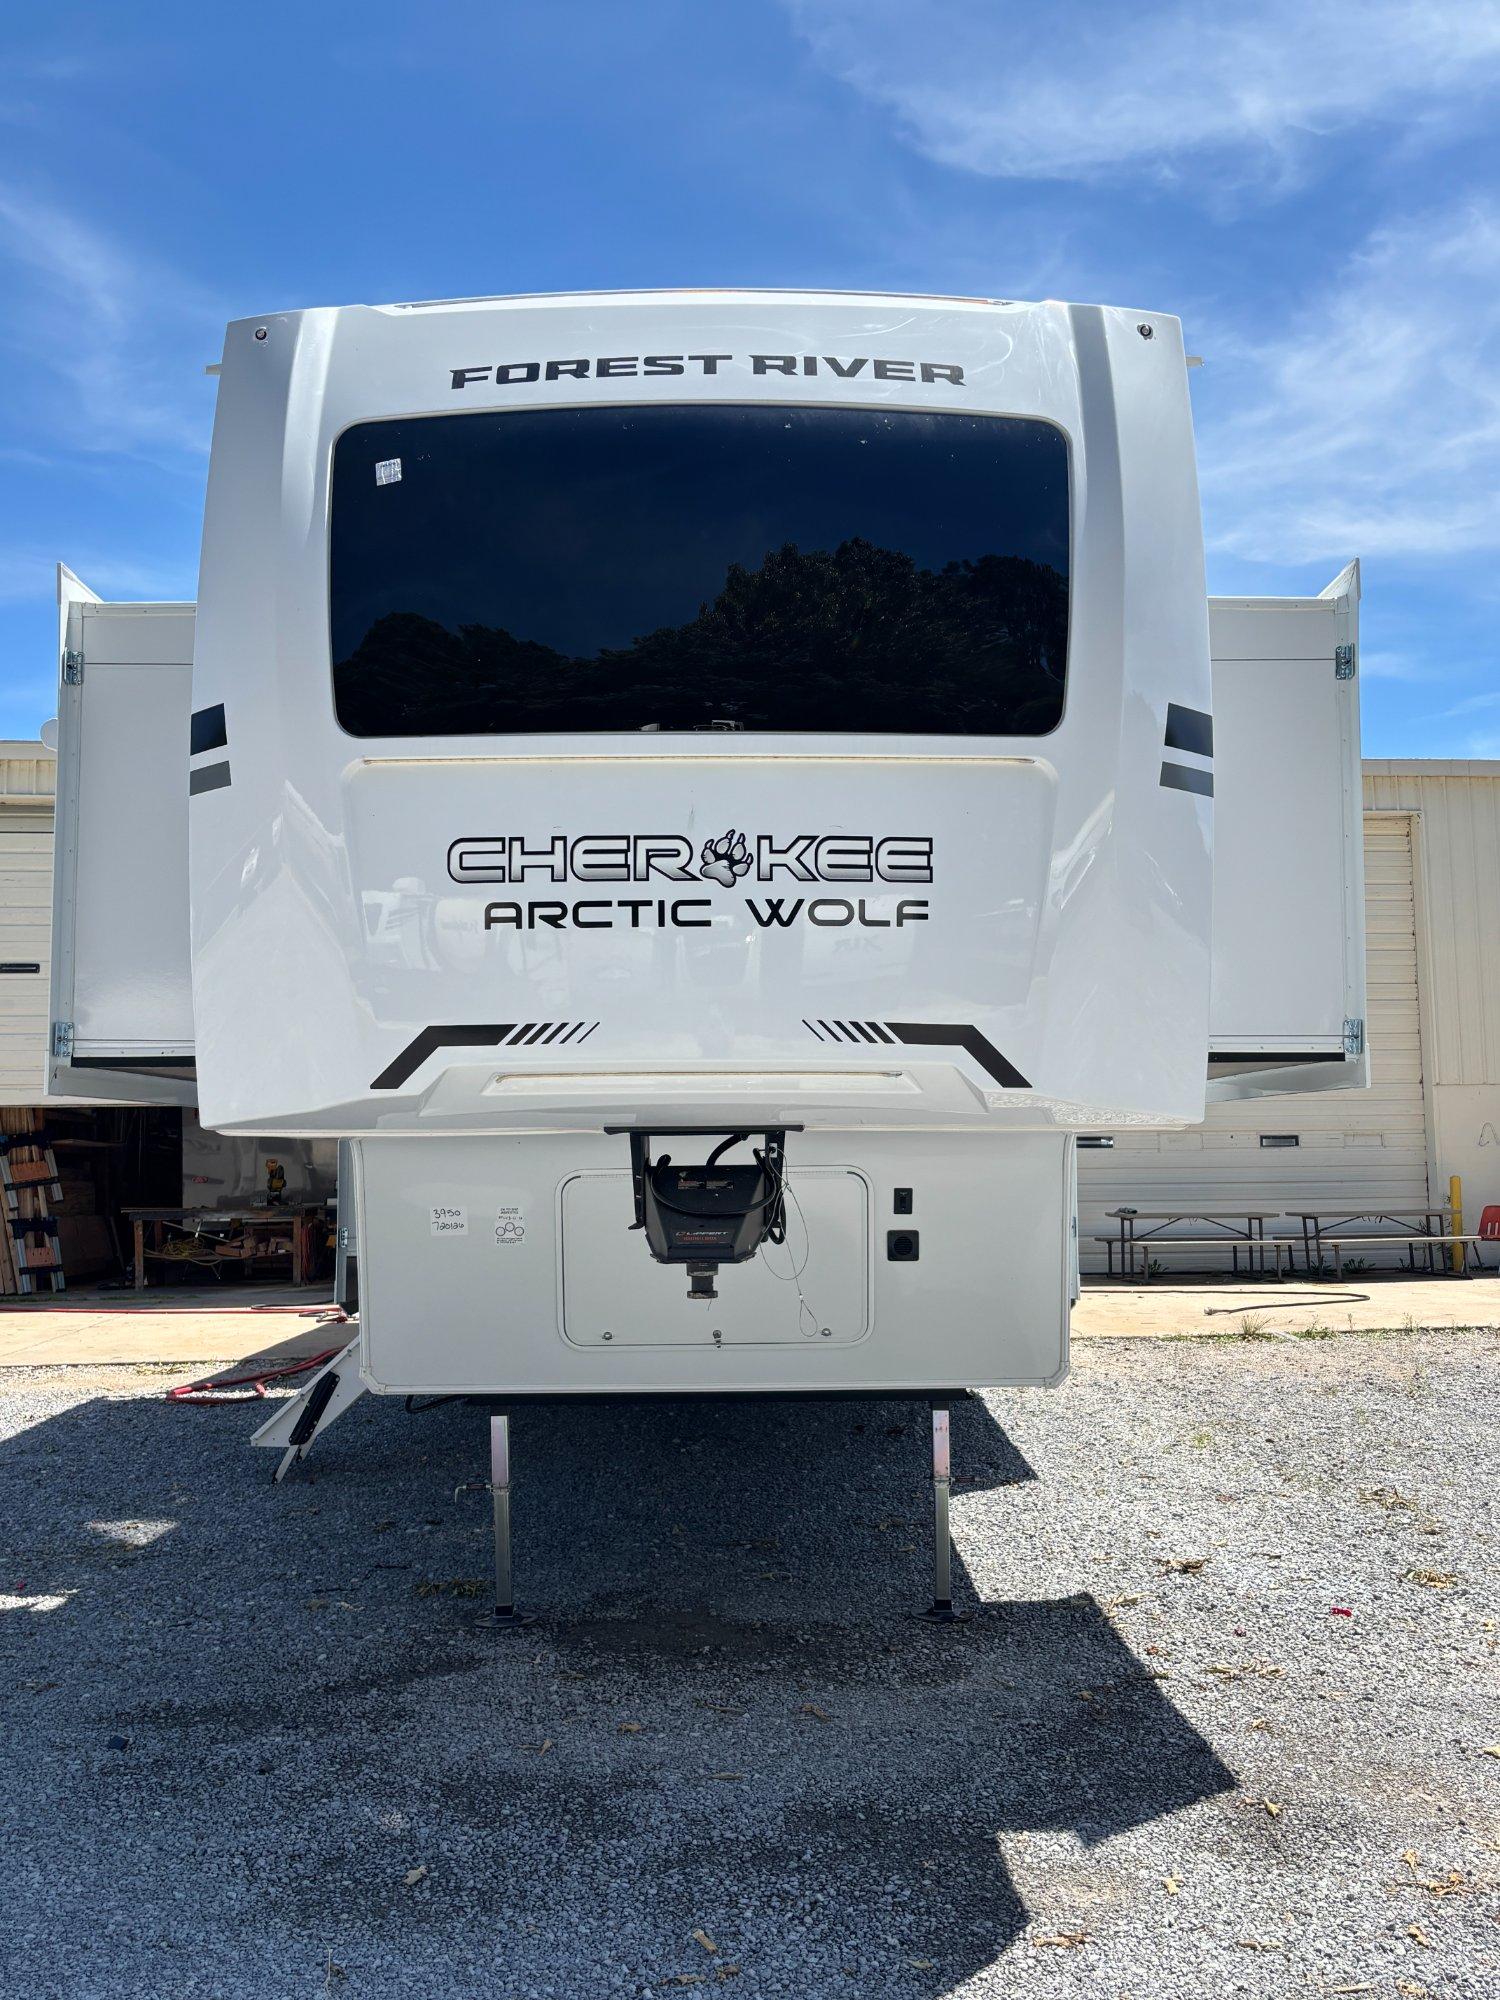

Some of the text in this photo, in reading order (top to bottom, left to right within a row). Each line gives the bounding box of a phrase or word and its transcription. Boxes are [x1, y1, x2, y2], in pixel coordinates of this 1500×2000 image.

[450, 354, 966, 390] FOREST RIVER
[484, 899, 712, 930] ARCTIC
[744, 898, 929, 928] WOLF
[433, 1208, 461, 1219] 3950
